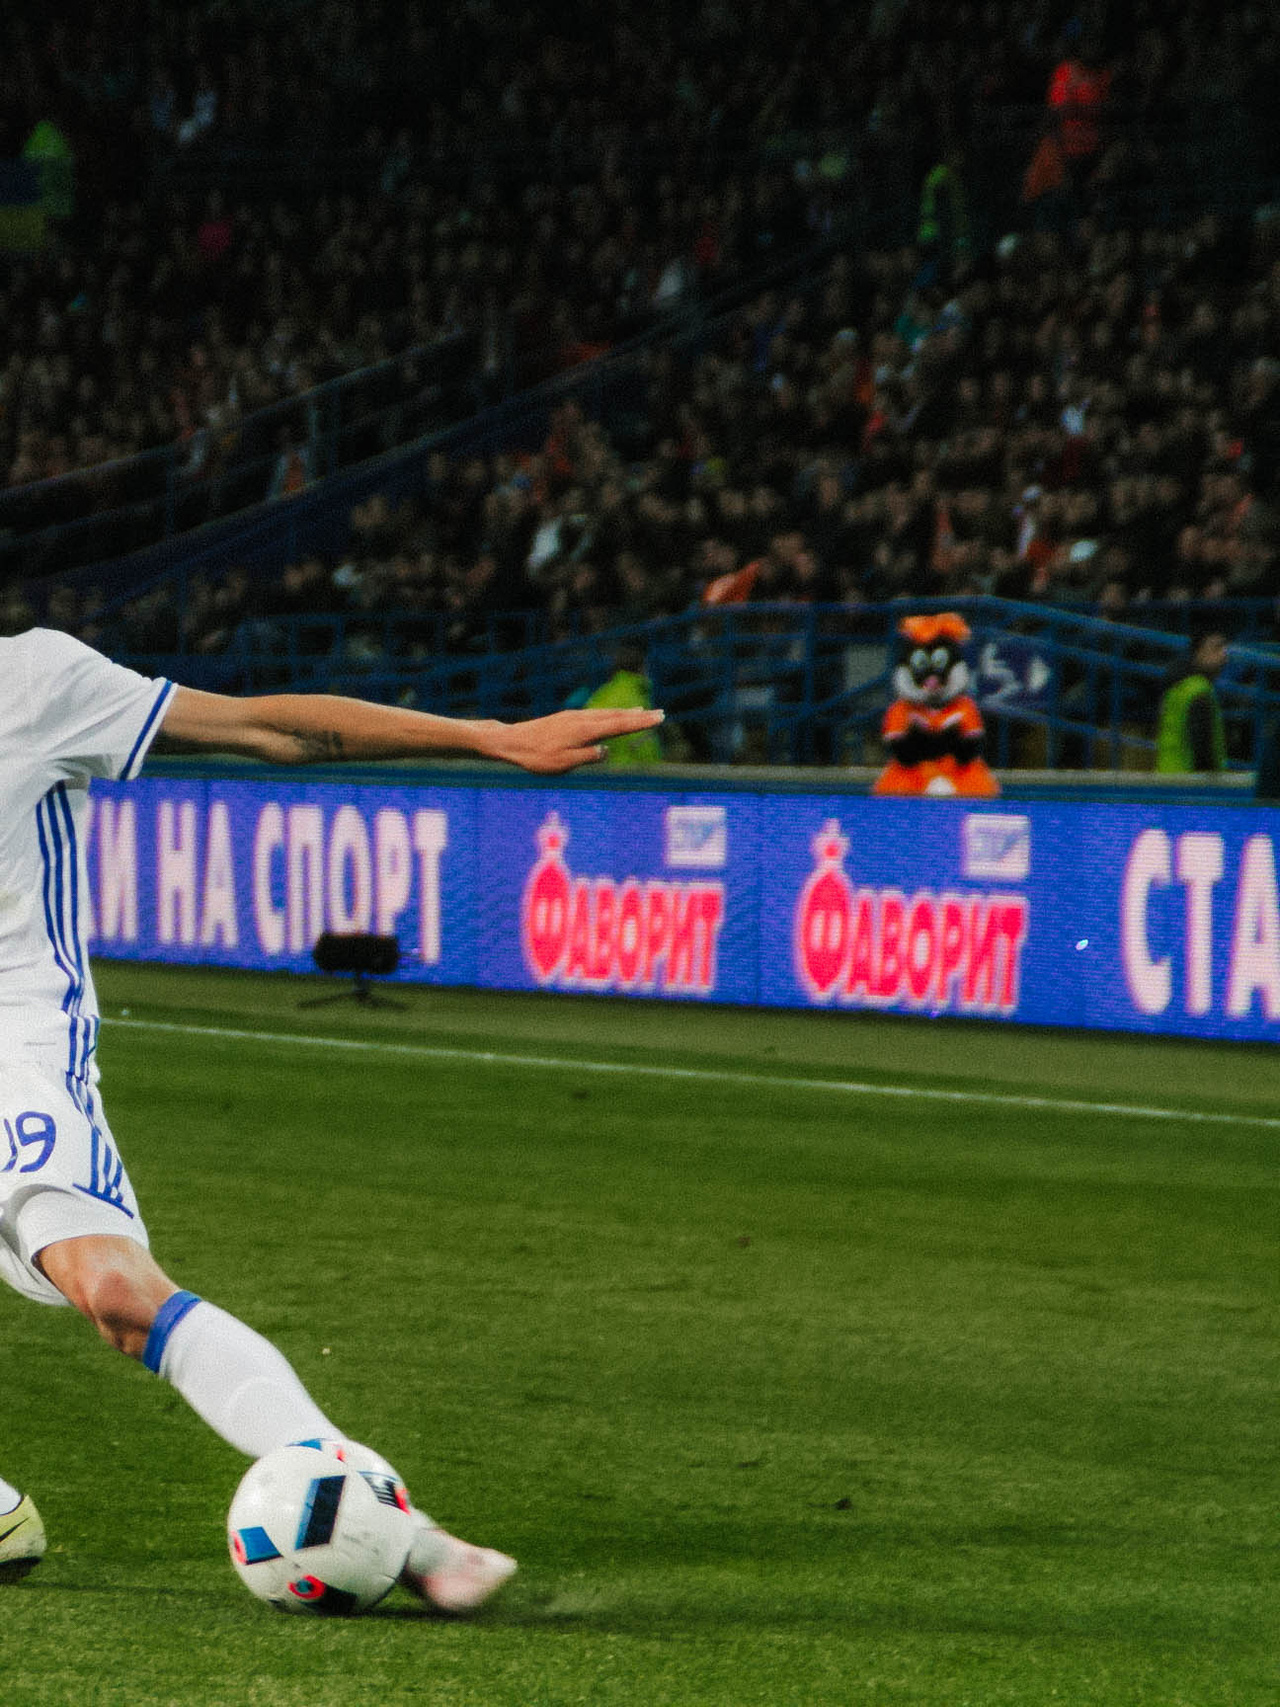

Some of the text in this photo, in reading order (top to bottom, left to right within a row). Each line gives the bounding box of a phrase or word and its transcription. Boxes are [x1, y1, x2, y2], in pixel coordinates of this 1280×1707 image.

[156, 800, 238, 950] НА
[252, 801, 448, 966] СПОРТ
[524, 852, 725, 998] ФАВОРИТ
[793, 862, 1031, 1015] ФАВОРИТ
